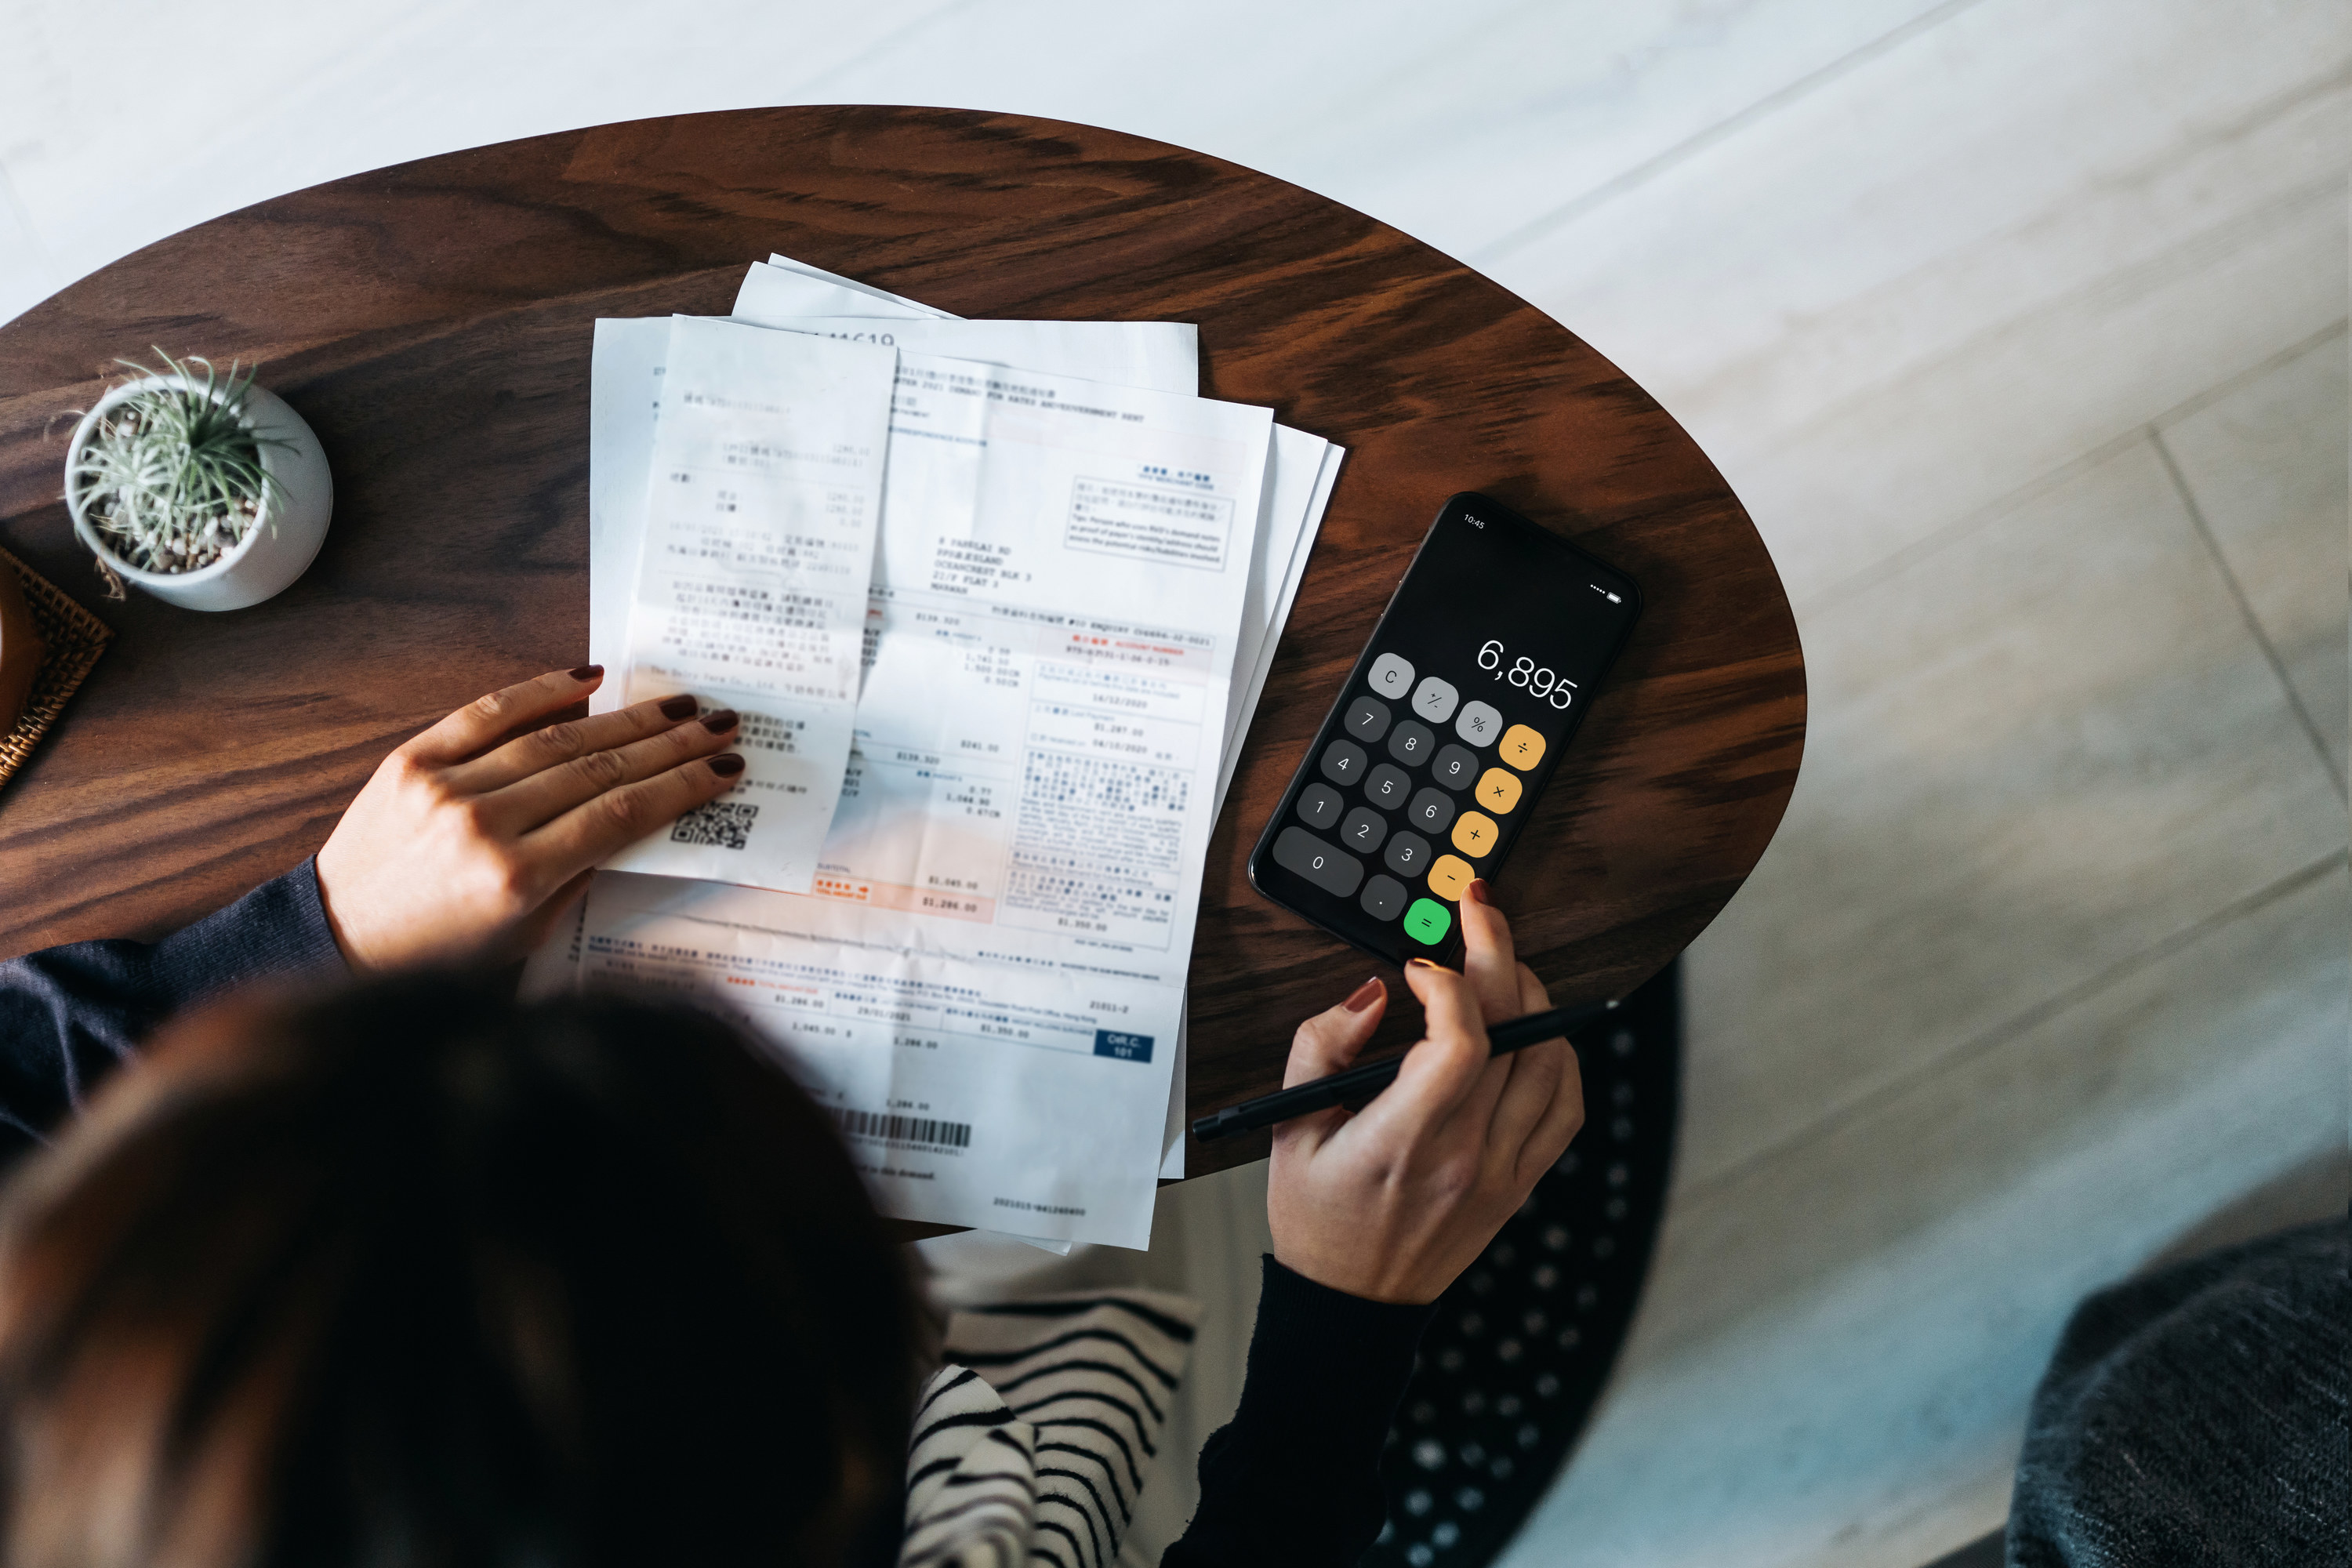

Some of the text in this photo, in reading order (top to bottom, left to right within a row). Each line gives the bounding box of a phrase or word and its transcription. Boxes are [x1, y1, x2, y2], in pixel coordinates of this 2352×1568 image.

[1464, 514, 1485, 530] 10:45
[1385, 670, 1397, 684] C
[1477, 640, 1578, 710] 6,895
[1363, 713, 1374, 725] 7
[1405, 737, 1417, 750] 8
[1338, 758, 1349, 771] 4
[1449, 761, 1461, 775] 9
[1381, 780, 1394, 794] 5
[1316, 800, 1324, 813] 1
[1425, 804, 1437, 818] 6
[1357, 824, 1370, 838] 2
[1401, 848, 1413, 862] 3
[1312, 856, 1324, 869] 0
